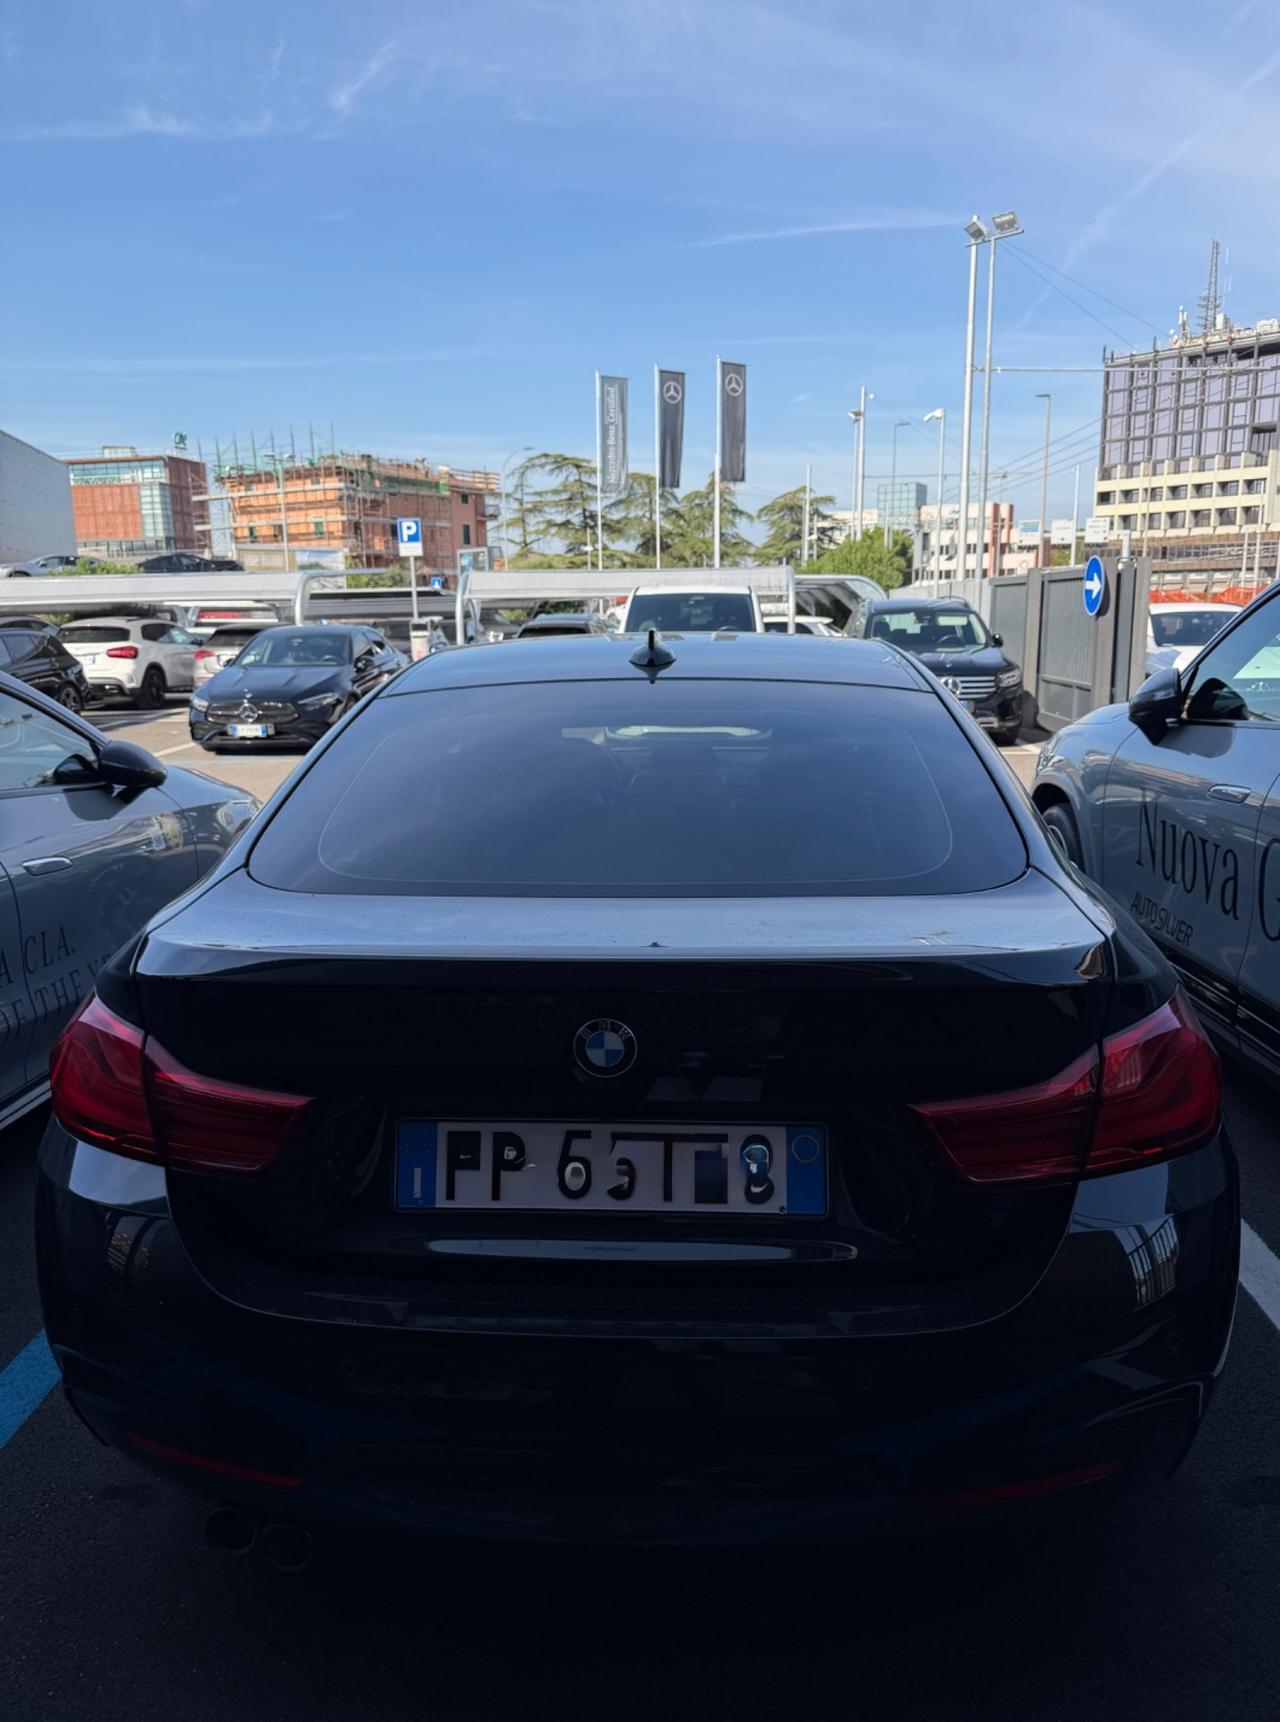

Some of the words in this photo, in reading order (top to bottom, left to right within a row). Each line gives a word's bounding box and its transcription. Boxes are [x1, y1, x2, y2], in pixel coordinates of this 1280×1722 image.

[401, 521, 417, 542] P
[1134, 786, 1240, 921] Nuova
[1130, 891, 1194, 947] AUTOSILVER
[24, 926, 76, 974] CLA.
